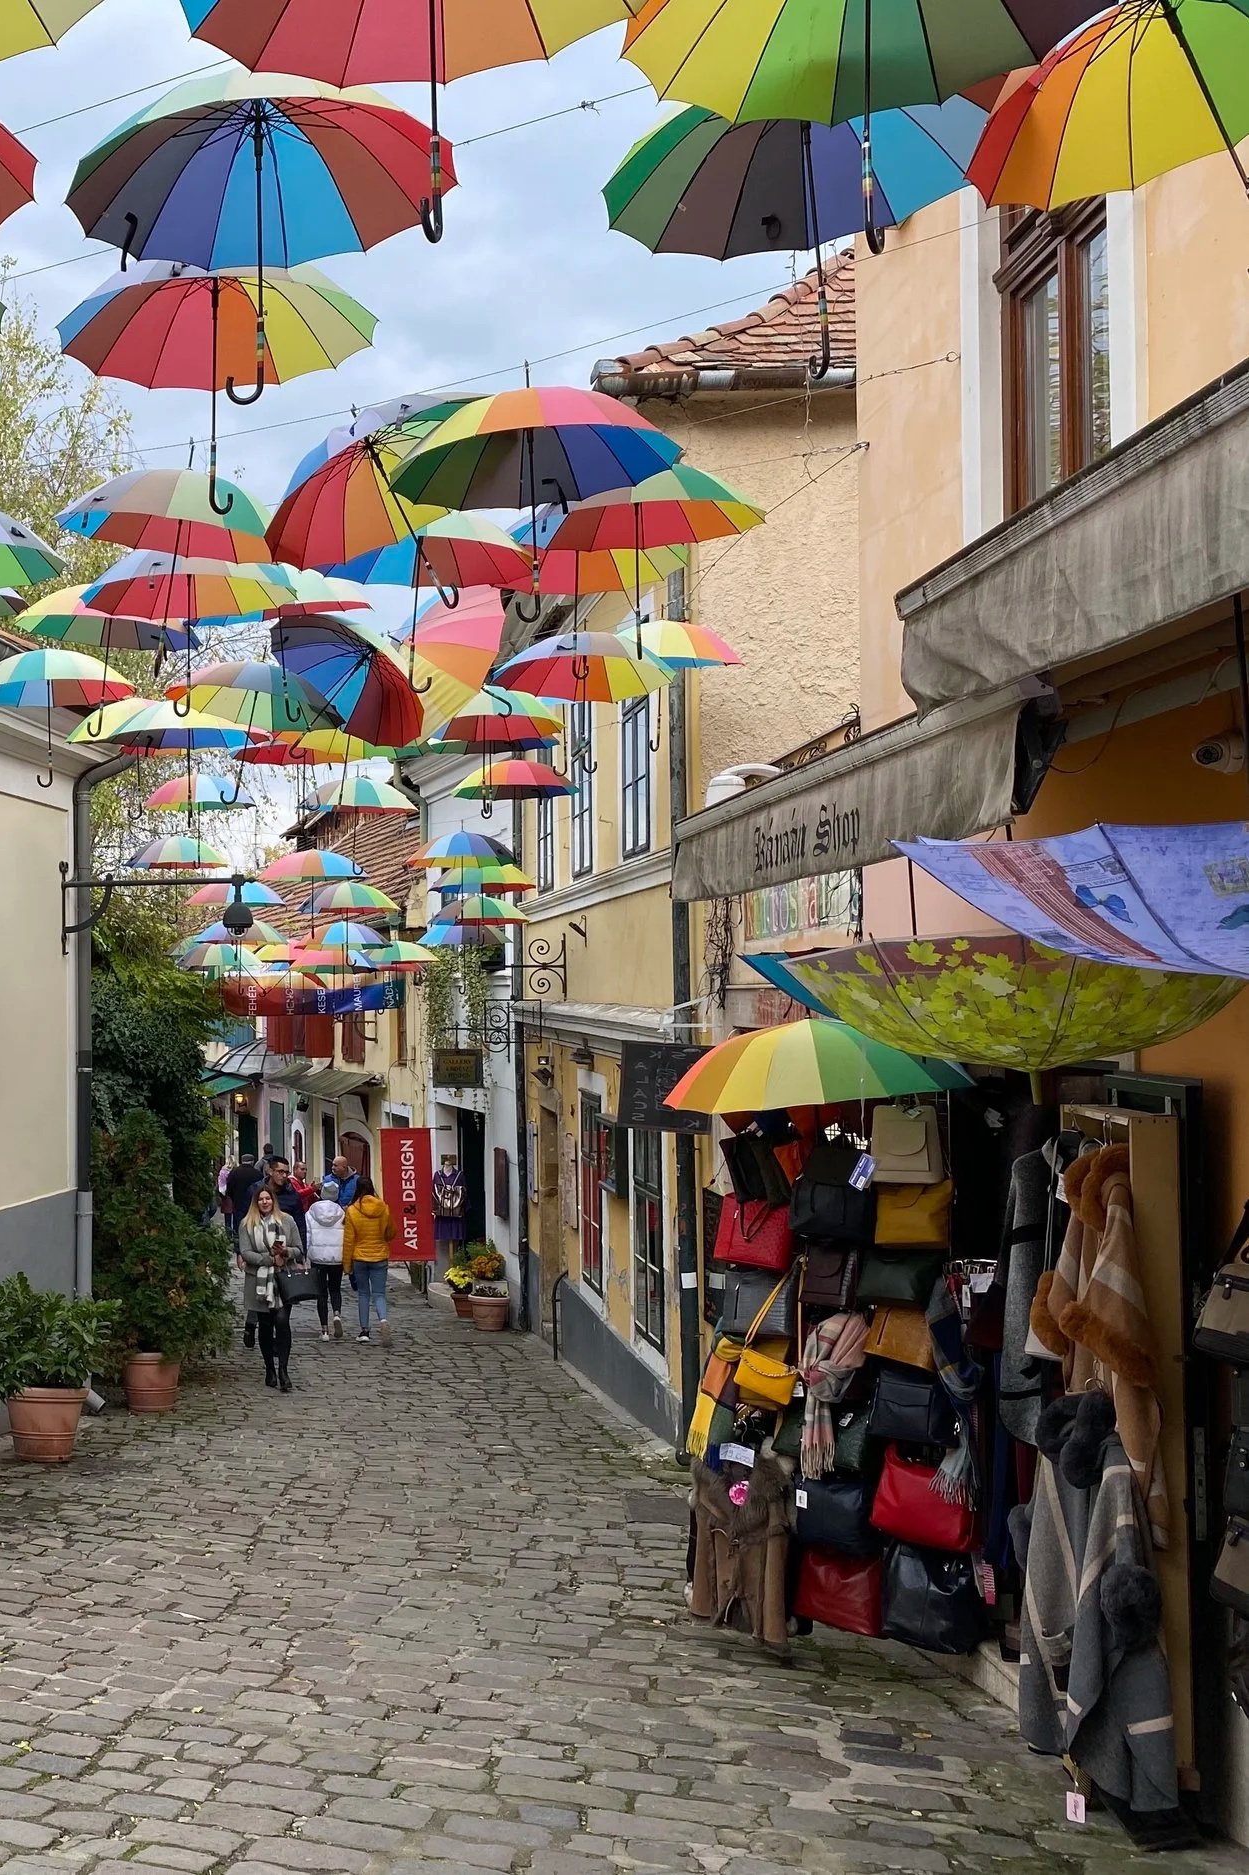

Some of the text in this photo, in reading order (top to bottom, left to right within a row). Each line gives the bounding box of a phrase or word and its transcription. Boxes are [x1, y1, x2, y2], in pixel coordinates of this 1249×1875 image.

[813, 801, 861, 860] Shop
[248, 984, 257, 1016] FEHÉR
[400, 1139, 418, 1250] ART & DESIGN
